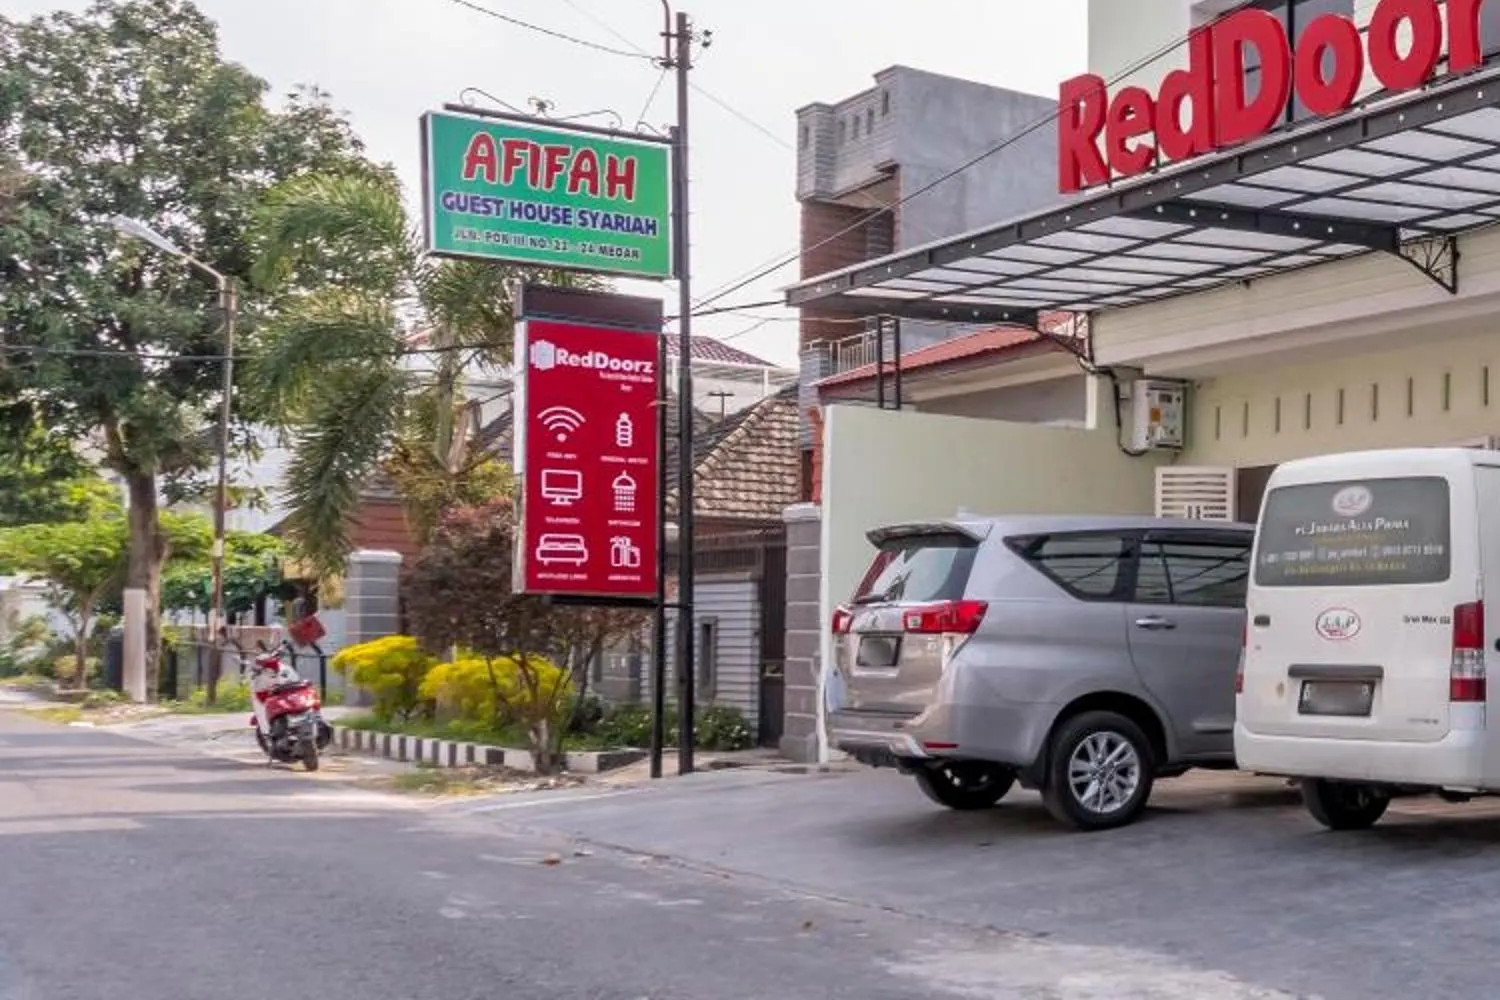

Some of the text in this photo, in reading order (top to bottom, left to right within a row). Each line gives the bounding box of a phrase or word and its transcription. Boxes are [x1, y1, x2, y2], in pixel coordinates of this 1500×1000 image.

[461, 131, 637, 202] AFIFAH
[441, 192, 657, 237] GUEST HOUSE SYARIAH
[556, 347, 654, 373] RedDoorz
